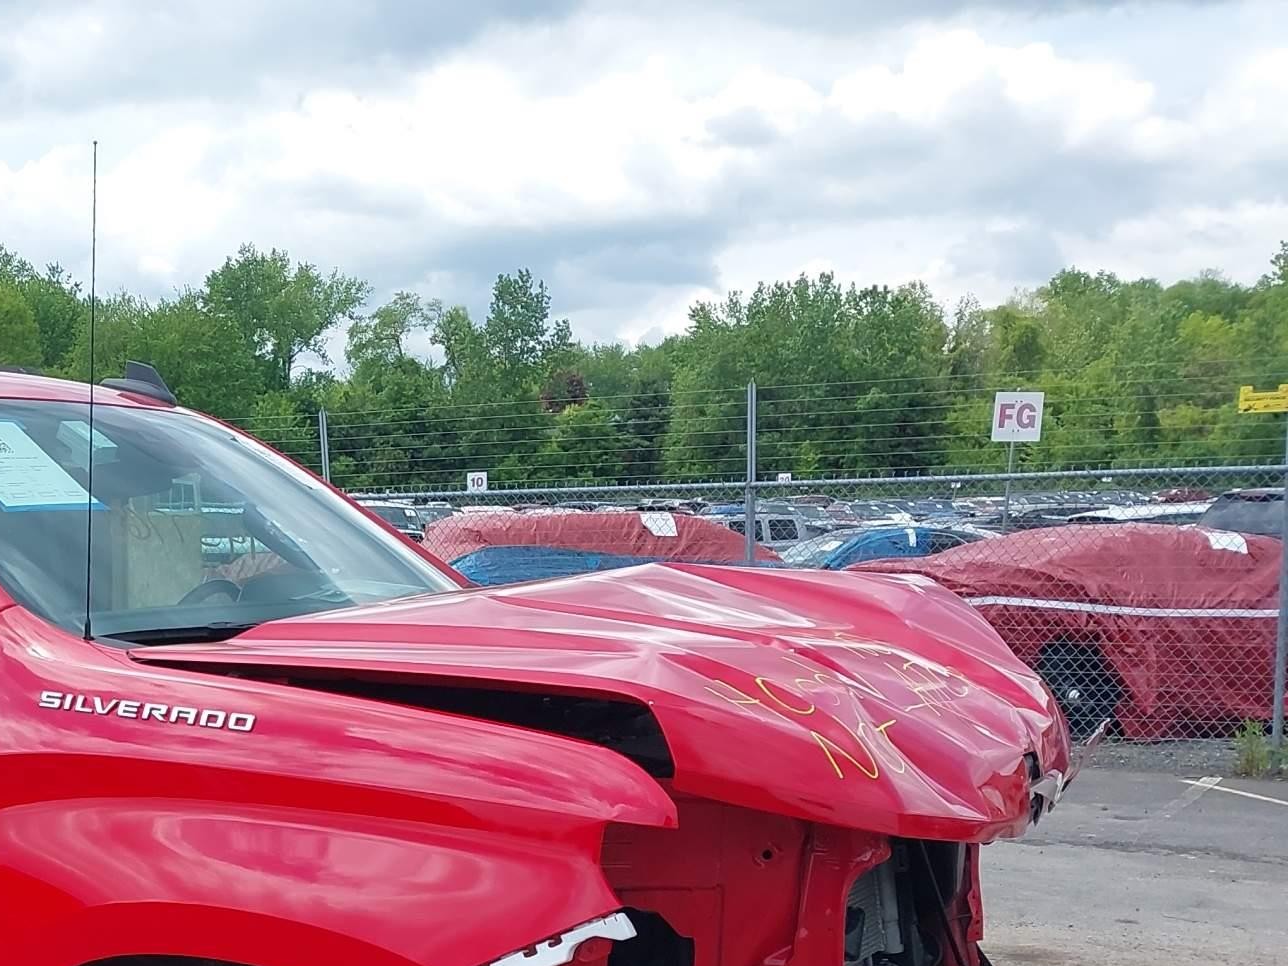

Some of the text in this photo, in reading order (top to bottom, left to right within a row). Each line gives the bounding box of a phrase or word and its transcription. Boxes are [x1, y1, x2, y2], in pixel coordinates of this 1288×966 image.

[998, 403, 1037, 429] FG
[471, 476, 484, 488] 10
[38, 690, 257, 732] SILVERADO
